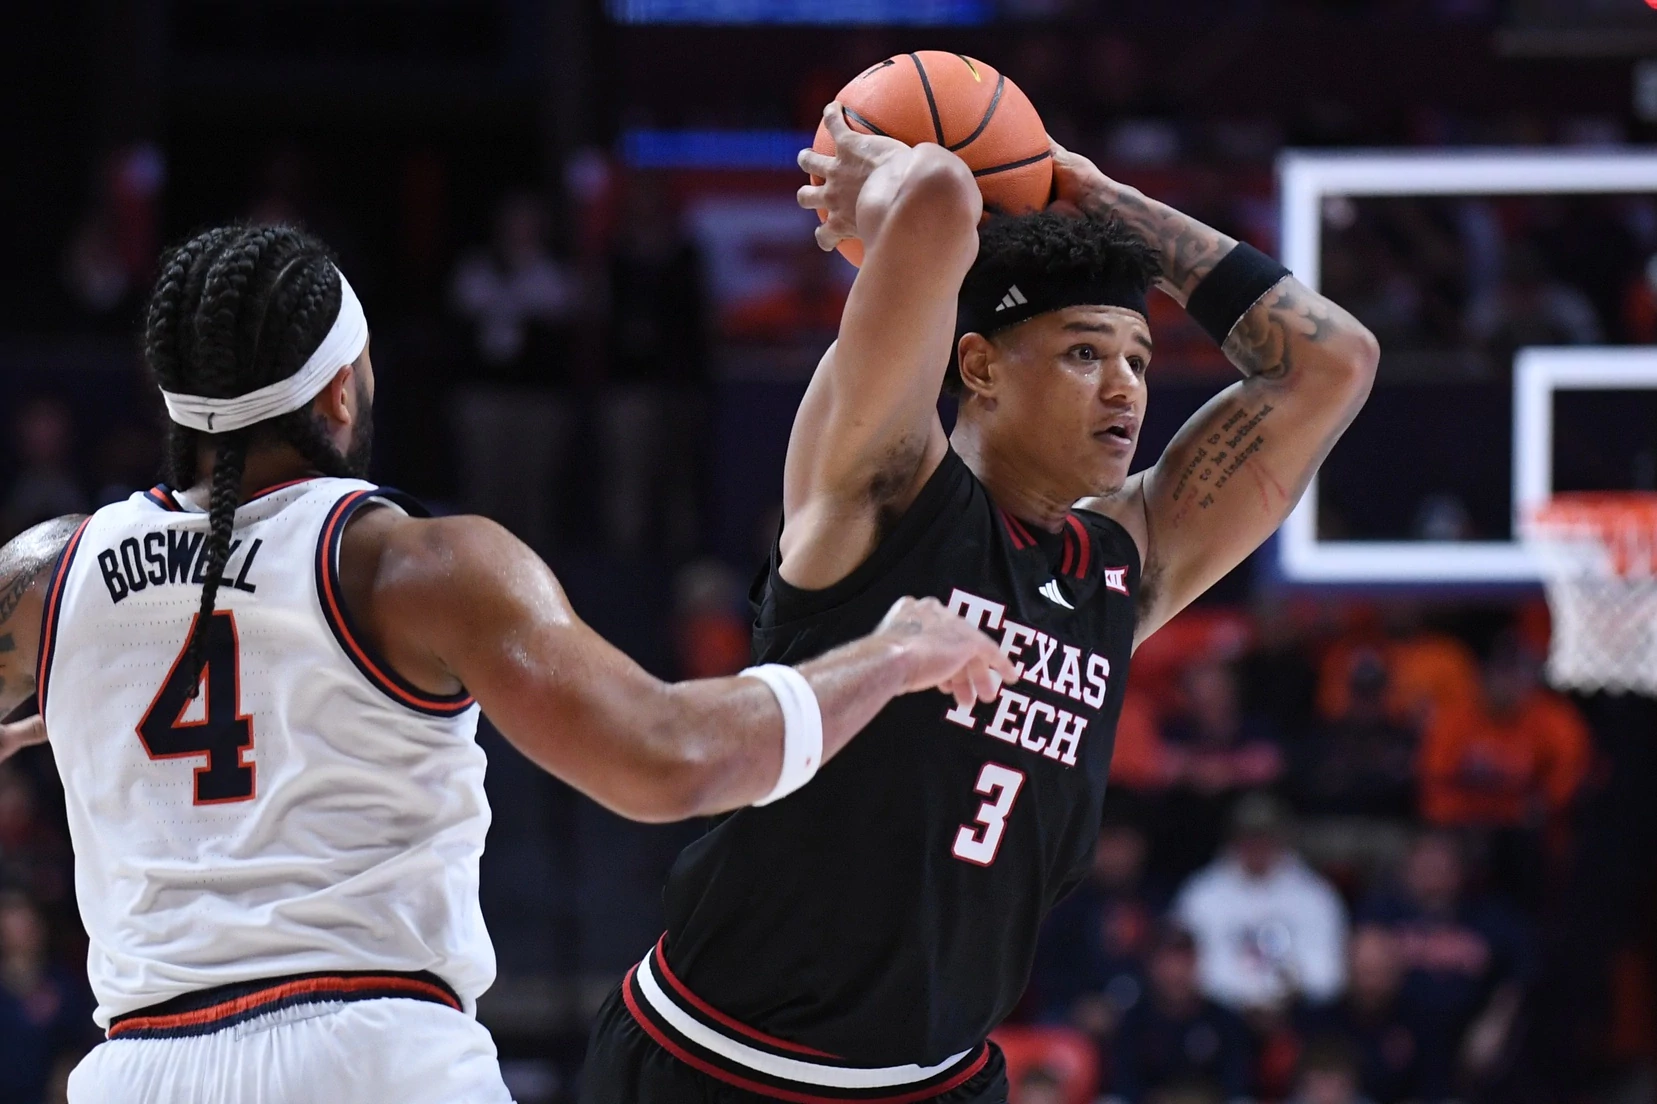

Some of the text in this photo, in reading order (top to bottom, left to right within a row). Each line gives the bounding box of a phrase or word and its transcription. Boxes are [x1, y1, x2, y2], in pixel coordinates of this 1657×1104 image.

[1198, 435, 1264, 509] by raindrops
[1199, 404, 1274, 481] to be bothered
[1208, 433, 1221, 445] to
[135, 609, 256, 806] 4
[951, 760, 1026, 867] 3
